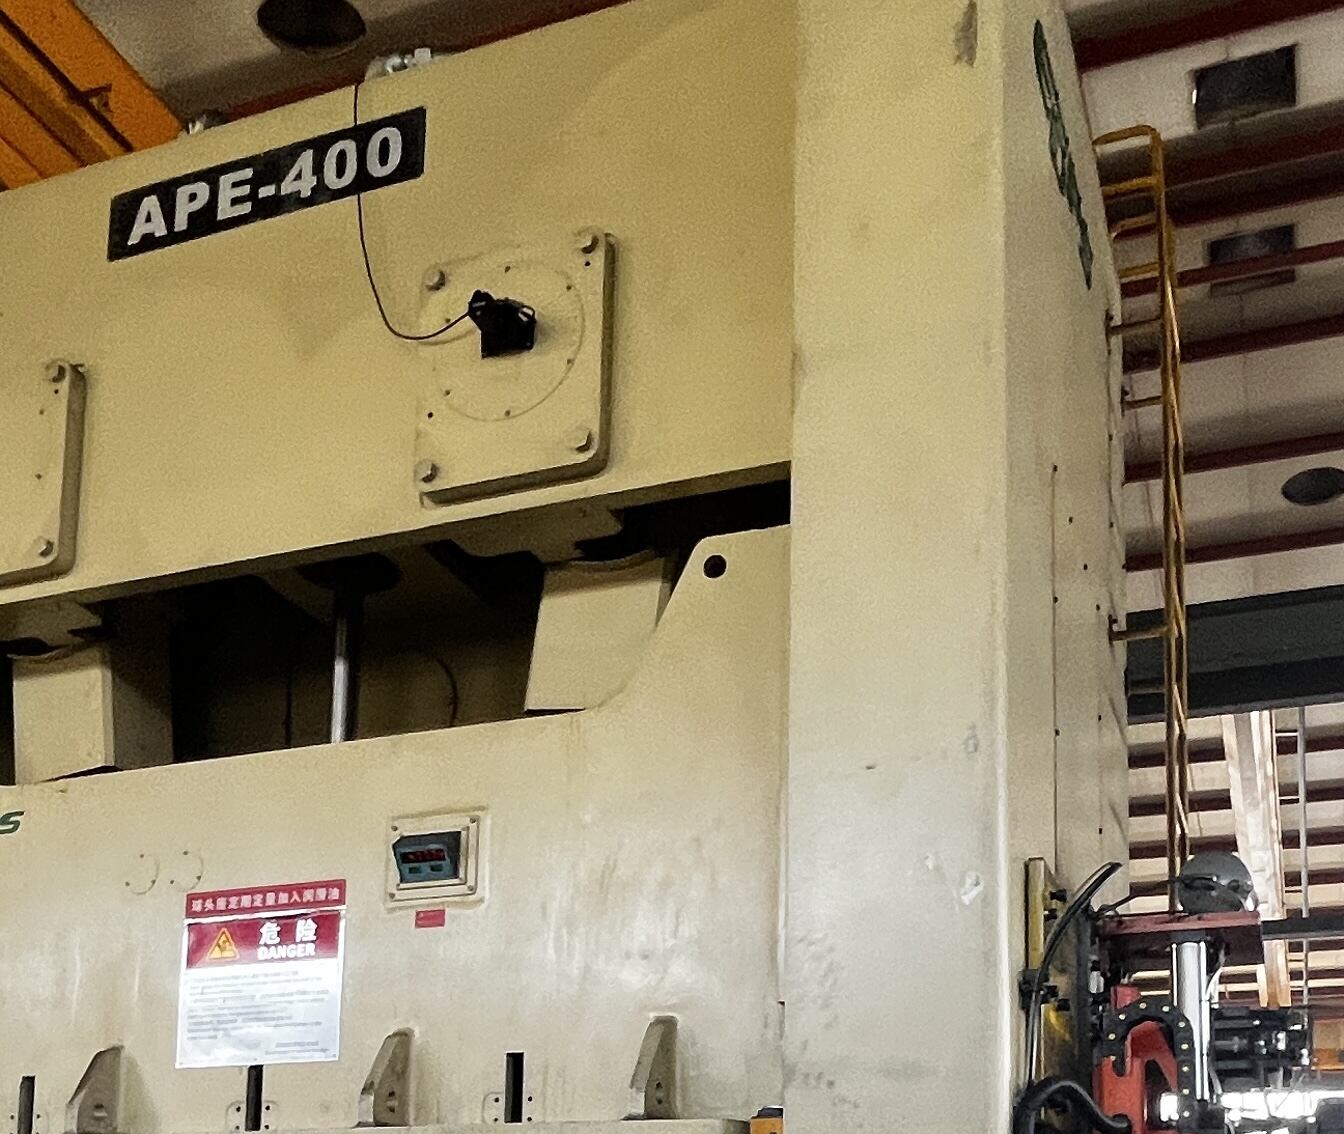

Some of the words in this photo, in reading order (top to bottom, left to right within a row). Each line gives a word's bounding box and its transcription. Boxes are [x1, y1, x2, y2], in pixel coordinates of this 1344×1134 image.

[127, 126, 403, 246] APE-400
[258, 917, 318, 945] 危险
[256, 942, 317, 961] DANGER
